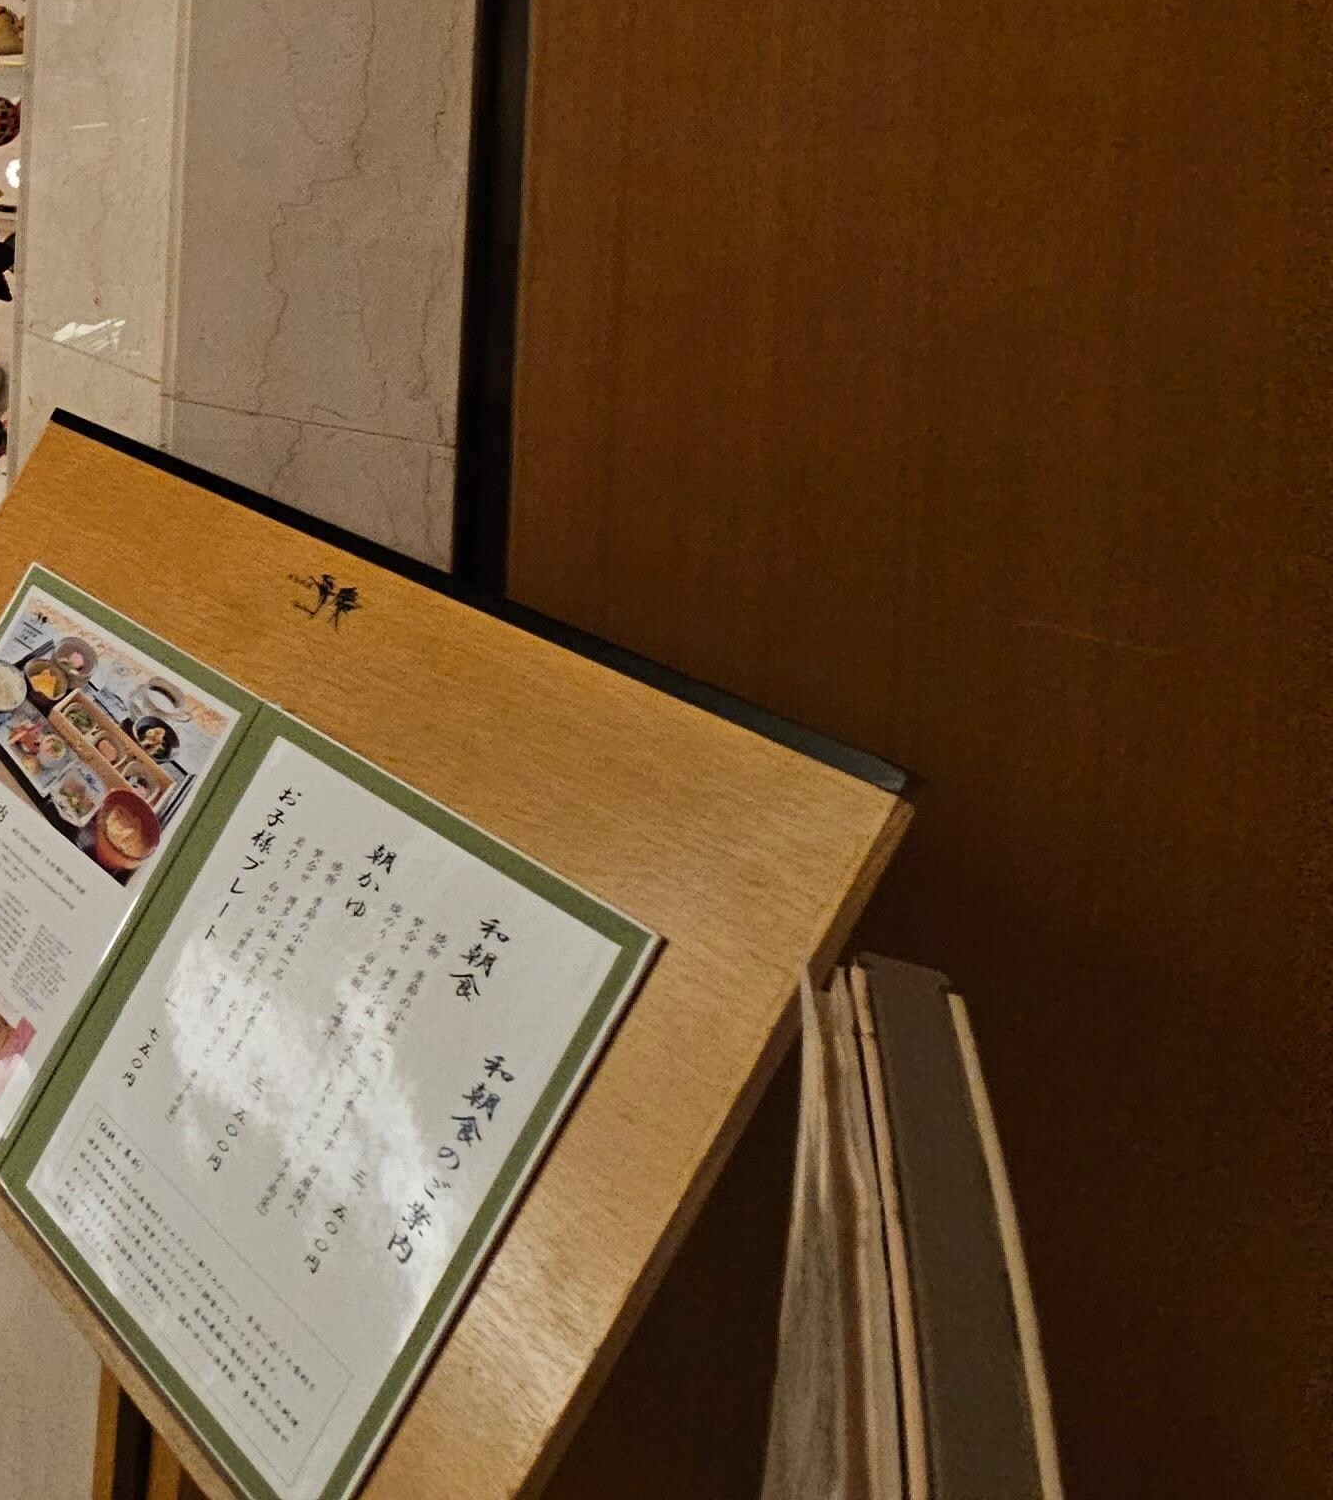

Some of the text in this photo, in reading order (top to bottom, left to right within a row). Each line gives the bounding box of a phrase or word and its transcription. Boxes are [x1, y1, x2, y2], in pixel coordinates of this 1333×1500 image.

[204, 787, 303, 941] お子様プレート
[344, 843, 398, 918] 朝かゆ
[448, 918, 511, 1003] 和朝食
[386, 1055, 516, 1265] 和朝食のご案内
